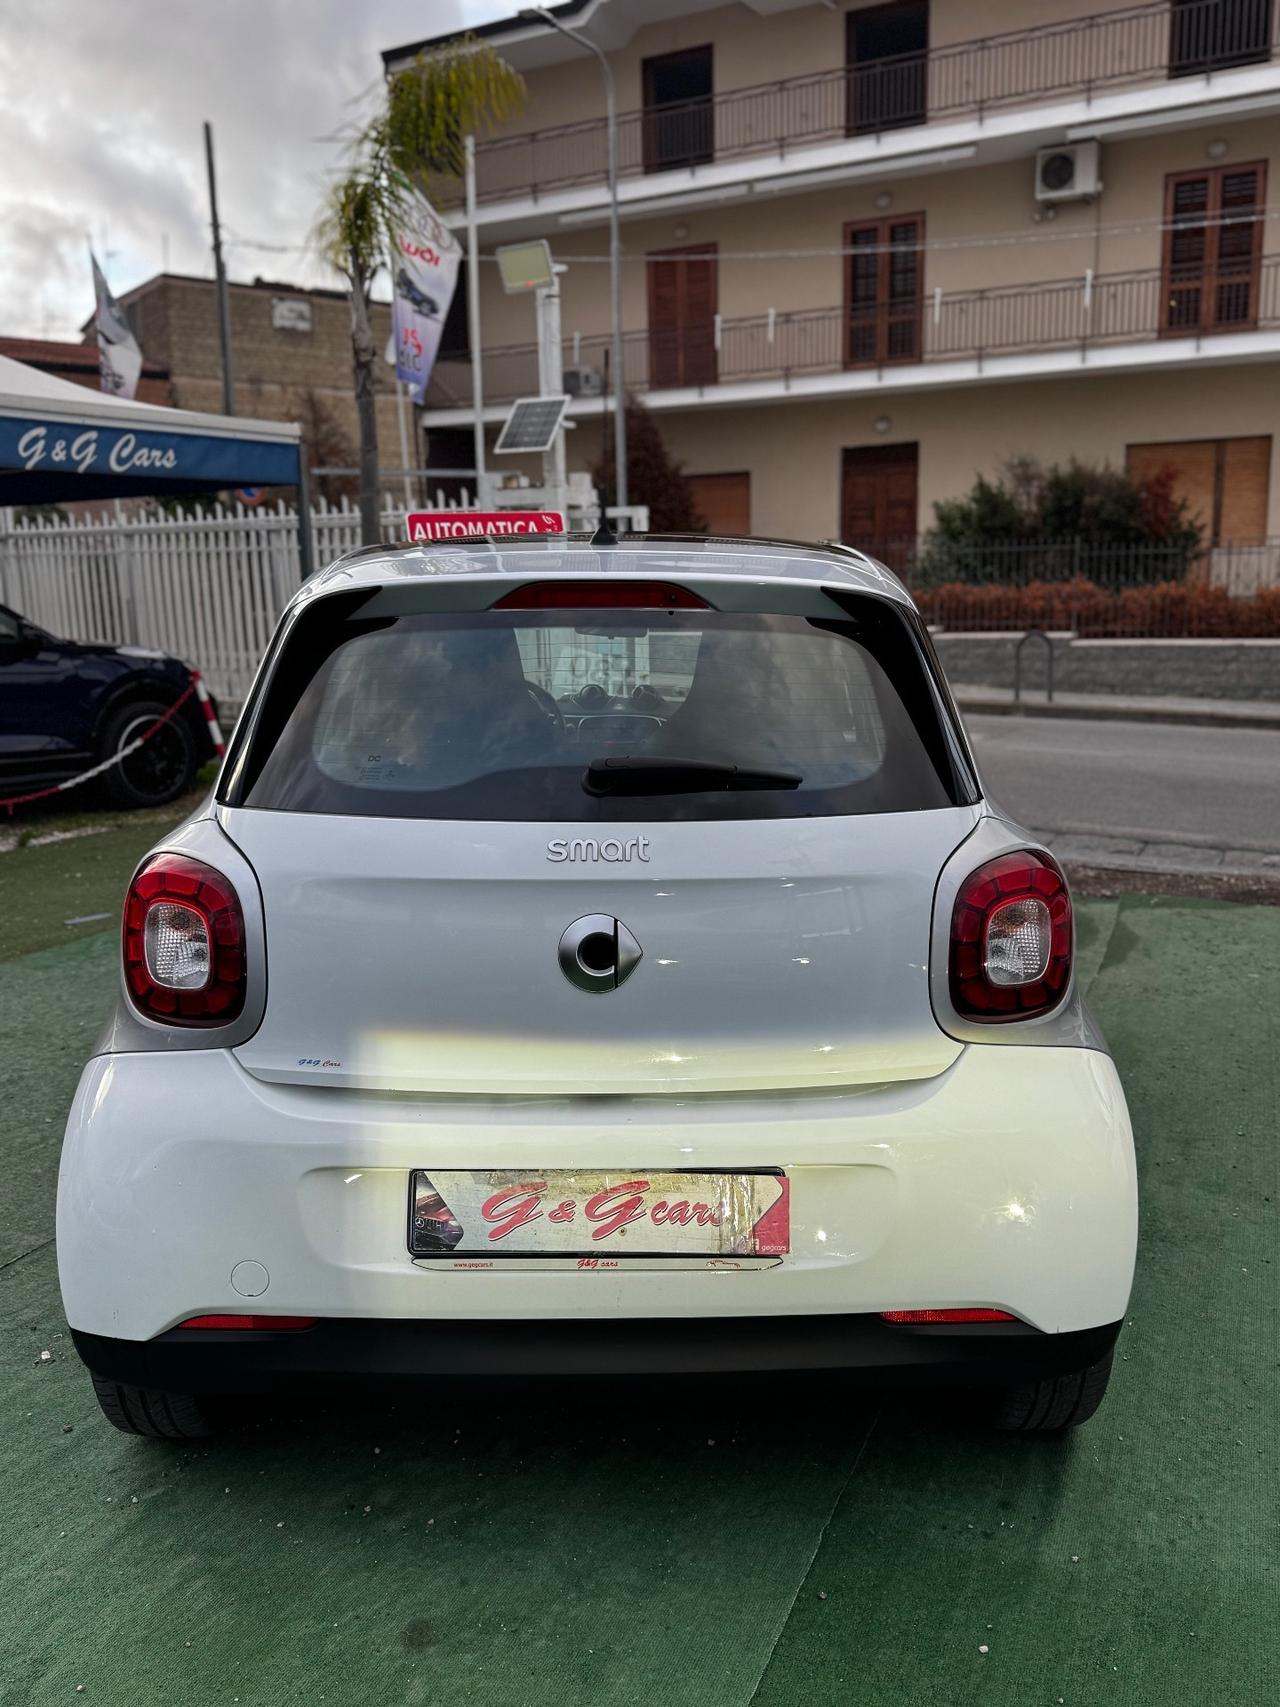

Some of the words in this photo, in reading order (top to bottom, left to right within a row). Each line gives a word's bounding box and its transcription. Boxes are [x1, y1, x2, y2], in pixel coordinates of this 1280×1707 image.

[108, 433, 178, 472] Cars
[413, 520, 538, 541] AUTOMATICA
[546, 835, 650, 862] smart
